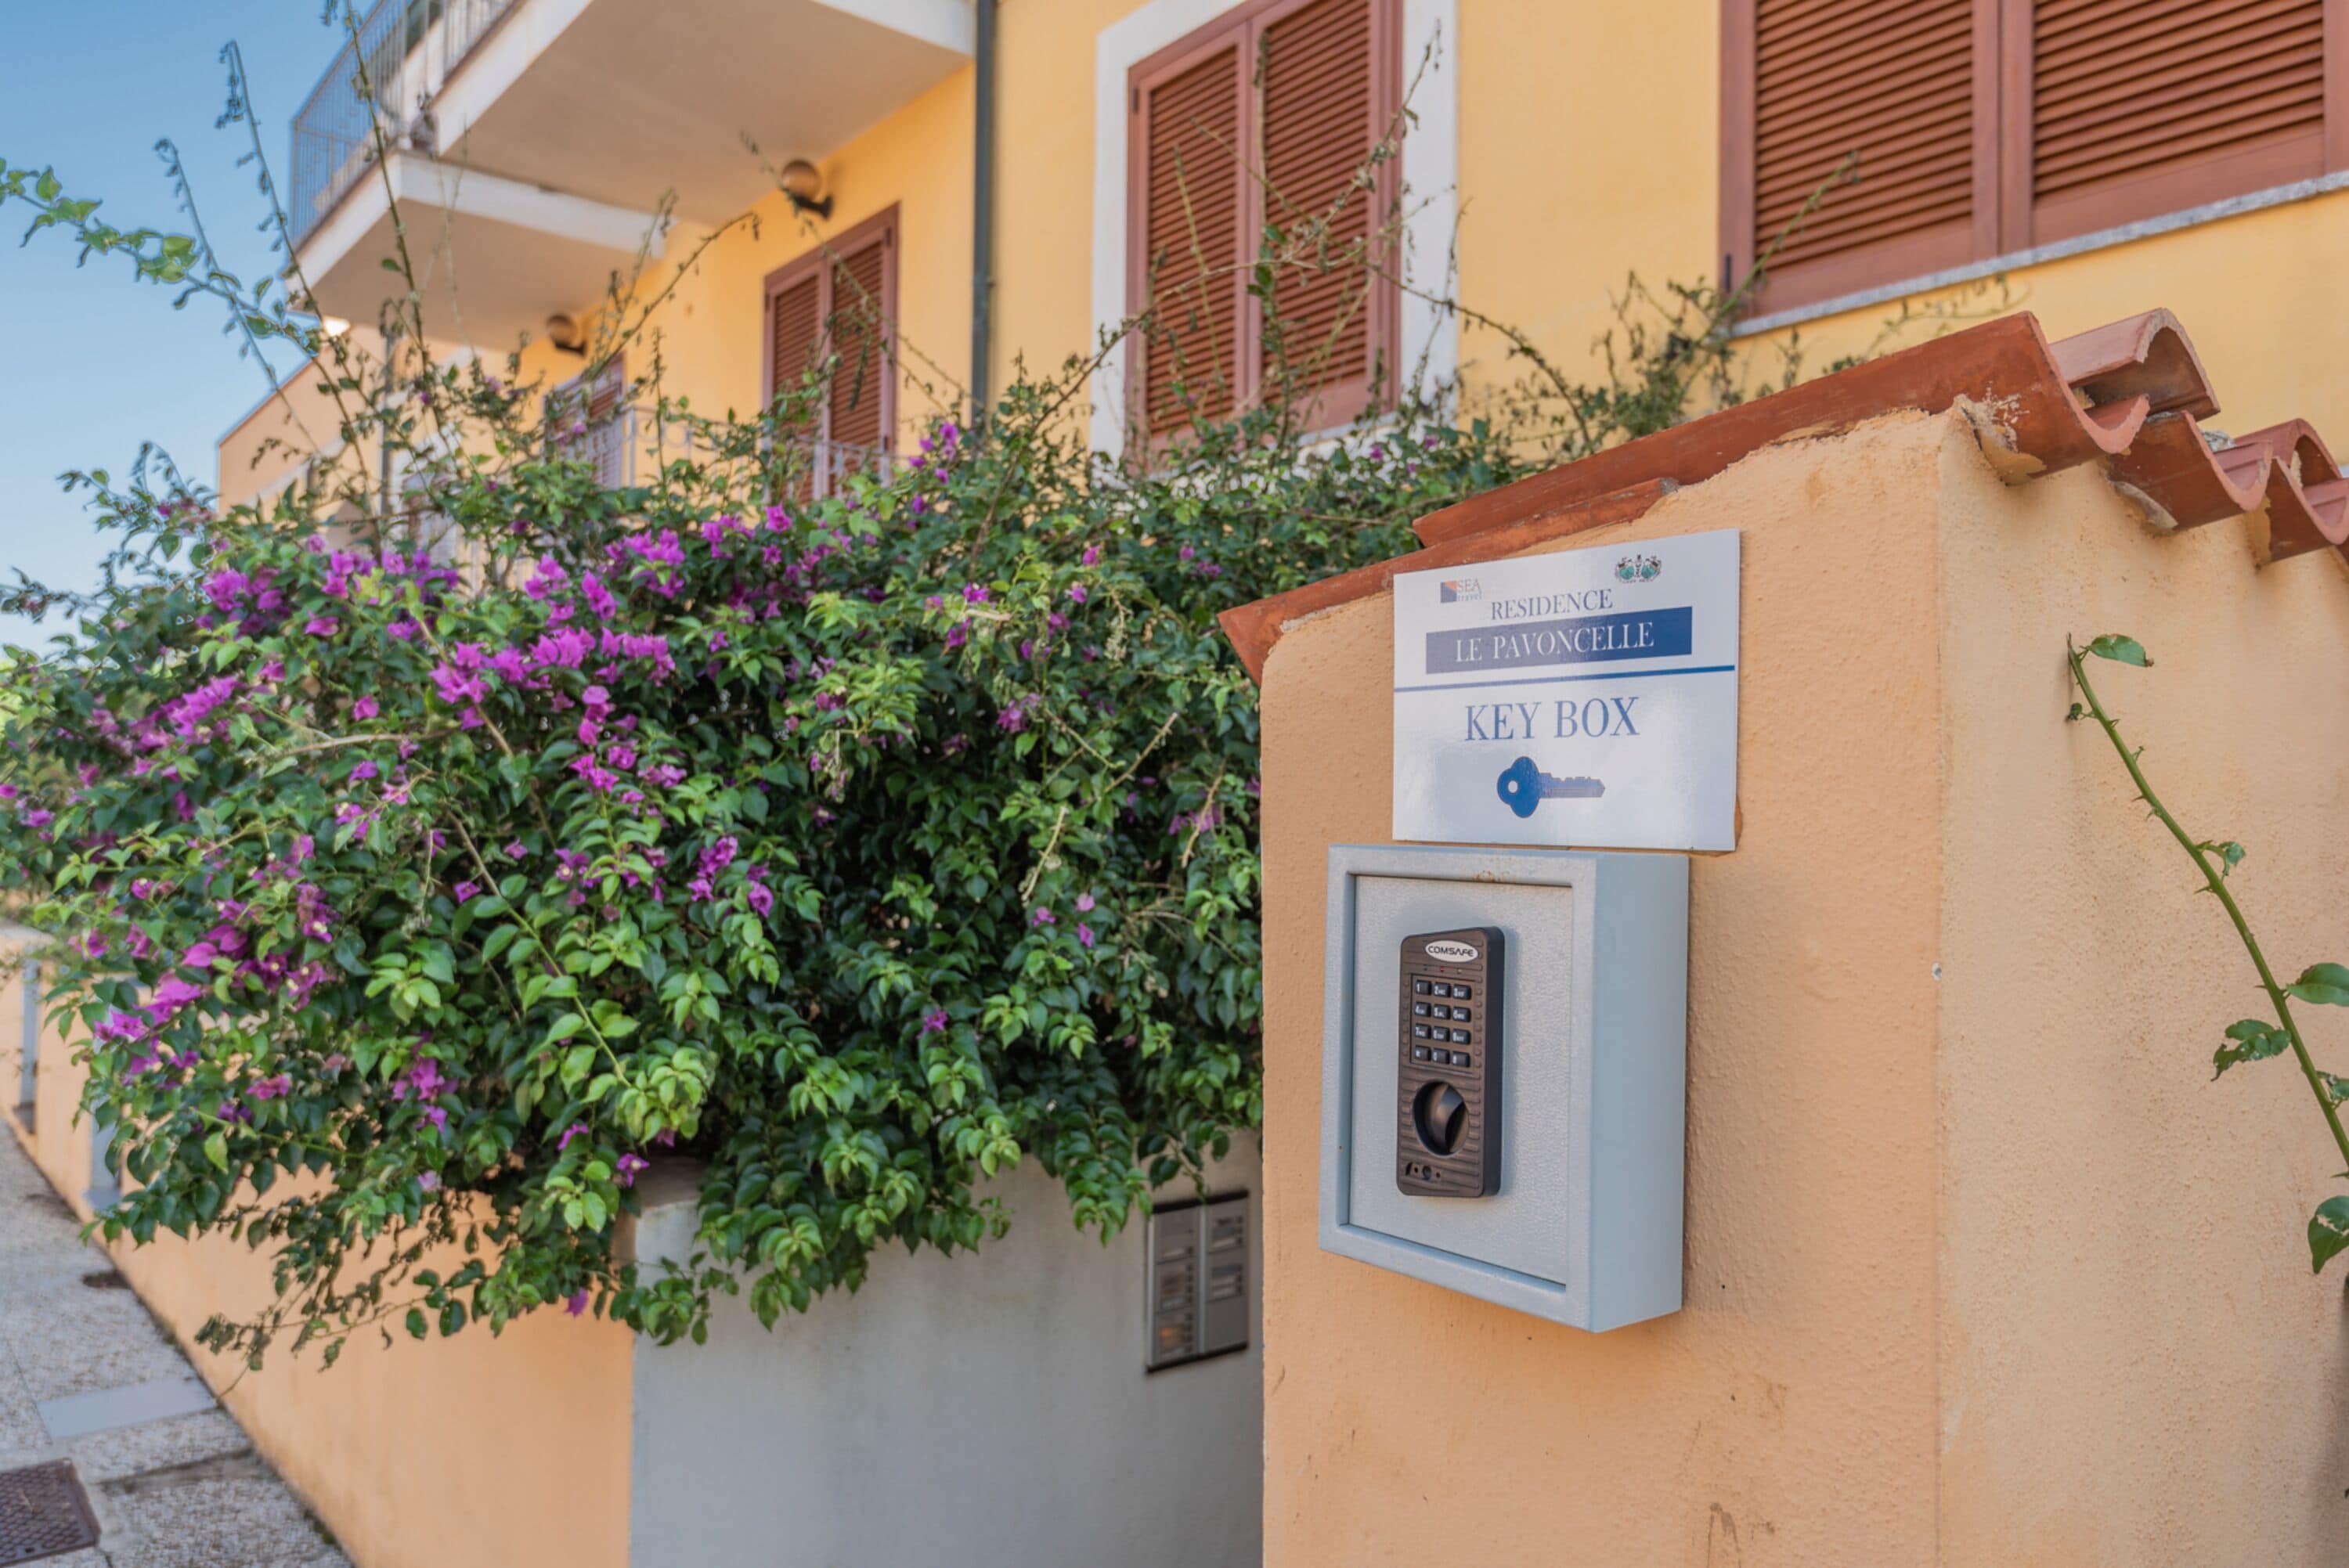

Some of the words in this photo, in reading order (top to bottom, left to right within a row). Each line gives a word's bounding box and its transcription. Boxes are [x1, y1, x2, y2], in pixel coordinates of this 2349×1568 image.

[1457, 579, 1481, 593] SEA
[1491, 588, 1614, 621] RESIDENCE
[1456, 638, 1482, 663] LE
[1493, 622, 1655, 660] PAVONCELLE
[1464, 701, 1542, 741] KEY
[1553, 696, 1641, 739] BOX
[1427, 945, 1474, 957] COMSAFE
